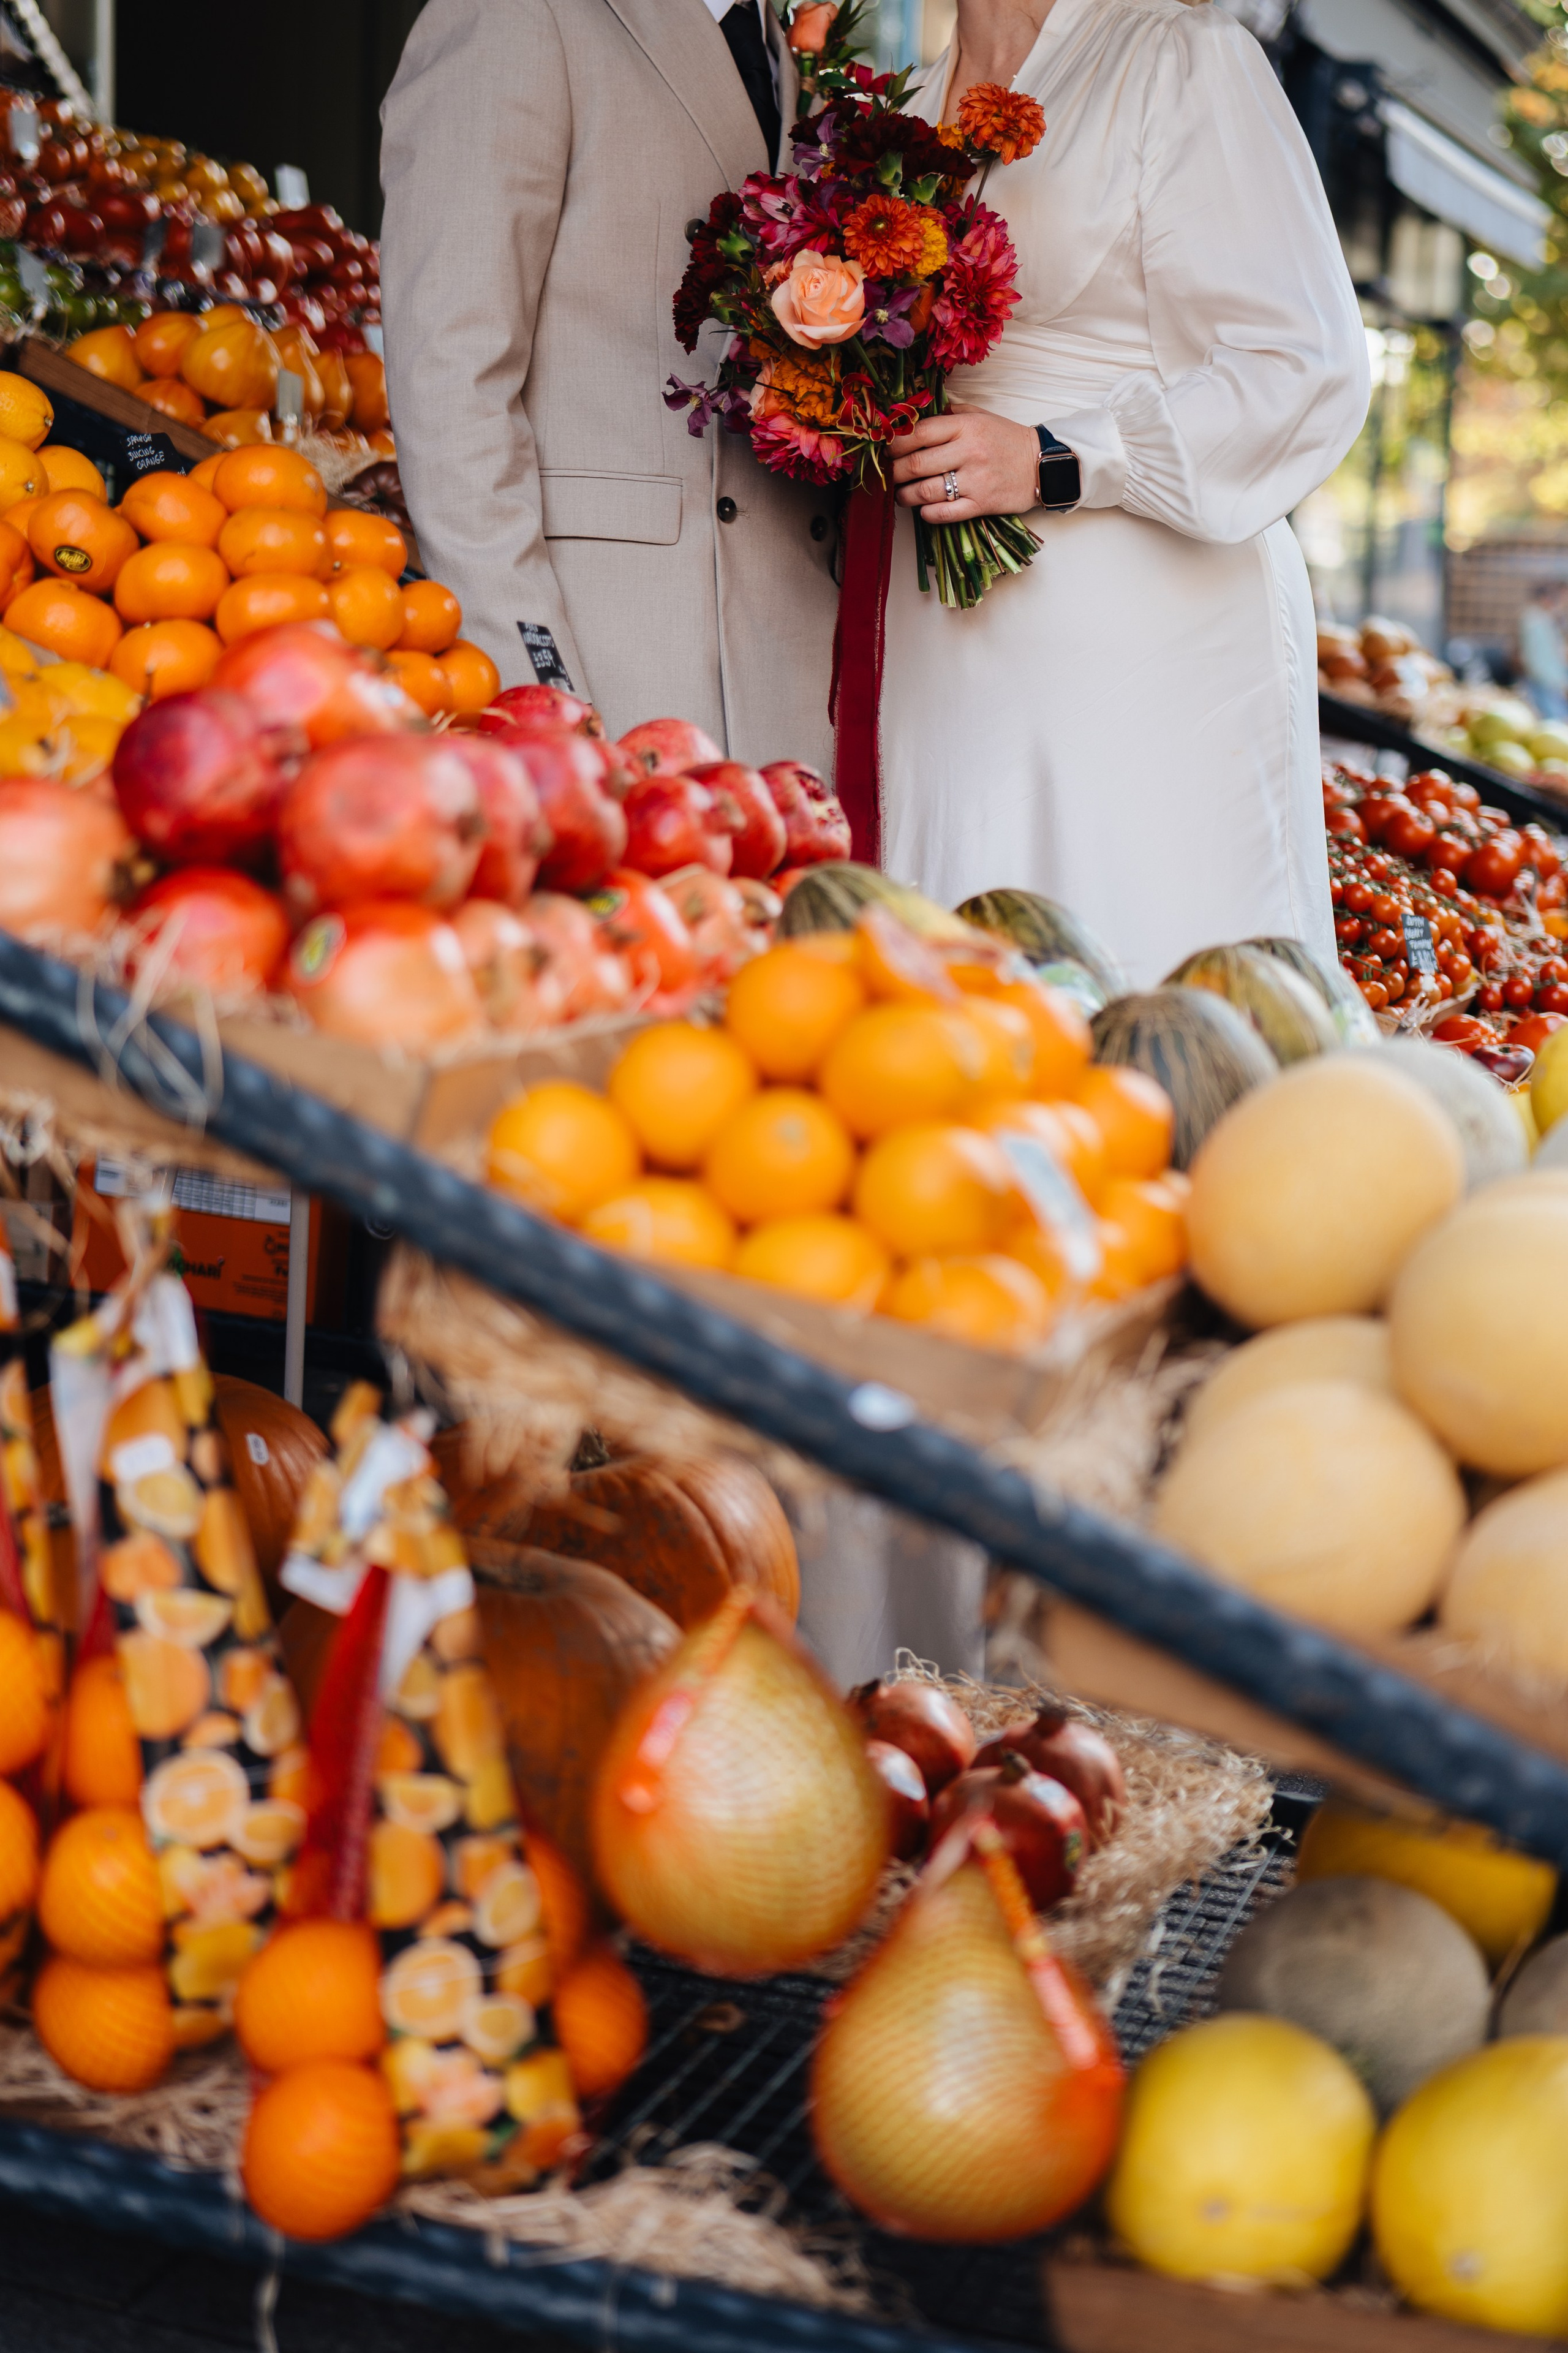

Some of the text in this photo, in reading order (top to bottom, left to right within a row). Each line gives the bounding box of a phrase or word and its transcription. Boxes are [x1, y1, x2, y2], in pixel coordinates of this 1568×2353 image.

[126, 433, 153, 447] SPANISH
[127, 445, 155, 462] JUICING
[136, 450, 165, 470] ORANGE
